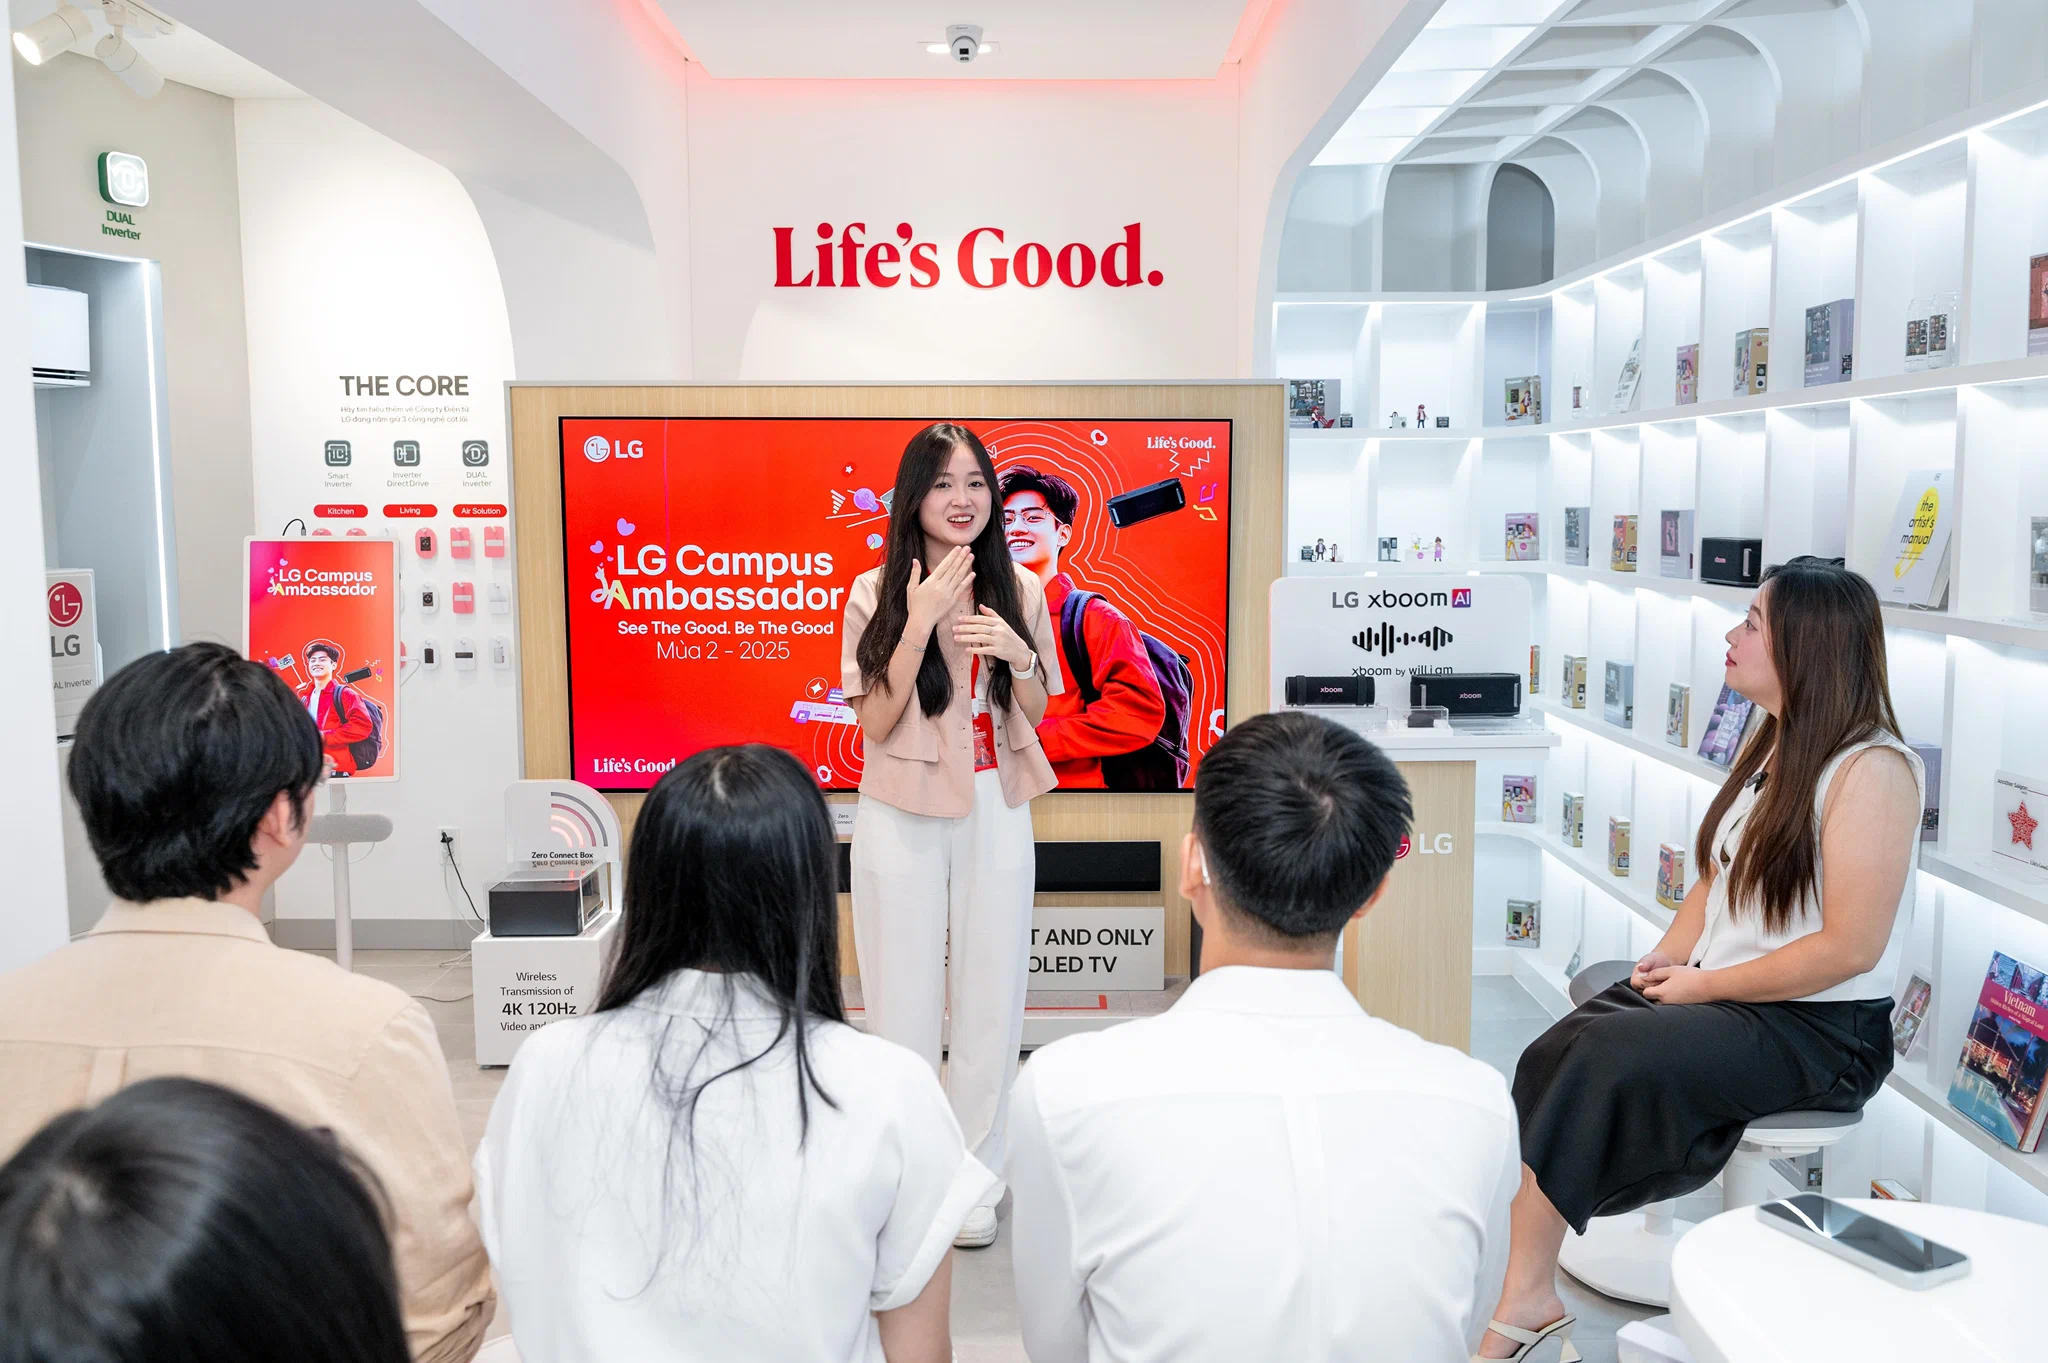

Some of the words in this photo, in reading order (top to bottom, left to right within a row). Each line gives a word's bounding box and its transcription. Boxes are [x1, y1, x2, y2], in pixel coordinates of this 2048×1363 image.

[106, 209, 136, 226] DUAL
[101, 223, 142, 240] Inverter
[772, 222, 940, 288] Life's
[957, 222, 1164, 288] Good.
[339, 375, 389, 396] THE
[395, 375, 469, 396] CORE
[614, 440, 644, 459] LG
[1147, 436, 1177, 449] Life's
[1179, 436, 1216, 449] Good.
[327, 472, 350, 480] Smart
[466, 471, 488, 479] DUAL
[327, 507, 355, 516] Kitchen
[399, 506, 421, 516] Living
[461, 507, 471, 515] Air
[472, 506, 501, 515] Solution
[1920, 496, 1934, 512] the
[1908, 515, 1935, 529] artist's
[1900, 529, 1934, 545] manual
[617, 544, 668, 575] LG
[676, 544, 834, 583] Campus
[279, 569, 301, 582] LG
[304, 569, 373, 585] Campus
[273, 583, 377, 596] Ambassador
[603, 580, 844, 610] Ambassador
[1332, 591, 1359, 608] LG
[1367, 590, 1448, 608] xboom
[1453, 592, 1470, 606] AI
[617, 621, 648, 635] See
[651, 621, 682, 635] The
[684, 621, 732, 635] Good.
[735, 621, 755, 635] Be
[758, 621, 789, 635] The
[791, 621, 834, 635] Good
[50, 634, 81, 658] LG
[656, 640, 701, 659] Mùa
[705, 641, 719, 659] 2
[739, 641, 790, 659] 2025
[1352, 666, 1392, 676] xboom
[1395, 668, 1406, 677] by
[53, 681, 64, 689] AL
[64, 678, 93, 689] Inverter
[593, 757, 632, 773] Life's
[1419, 833, 1453, 854] LG
[531, 851, 548, 859] Zero
[549, 851, 579, 859] Connect
[580, 851, 594, 859] Box
[1044, 928, 1092, 946] AND
[1097, 928, 1154, 947] ONLY
[1028, 955, 1084, 974] OLED
[1088, 956, 1117, 973] TV
[516, 972, 557, 982] Wireless
[500, 986, 561, 997] Transmission
[564, 986, 575, 997] of
[502, 1002, 523, 1015] 4K
[528, 1002, 577, 1015] 120Hz
[2004, 990, 2036, 1018] Vietnam
[500, 1021, 527, 1031] Video
